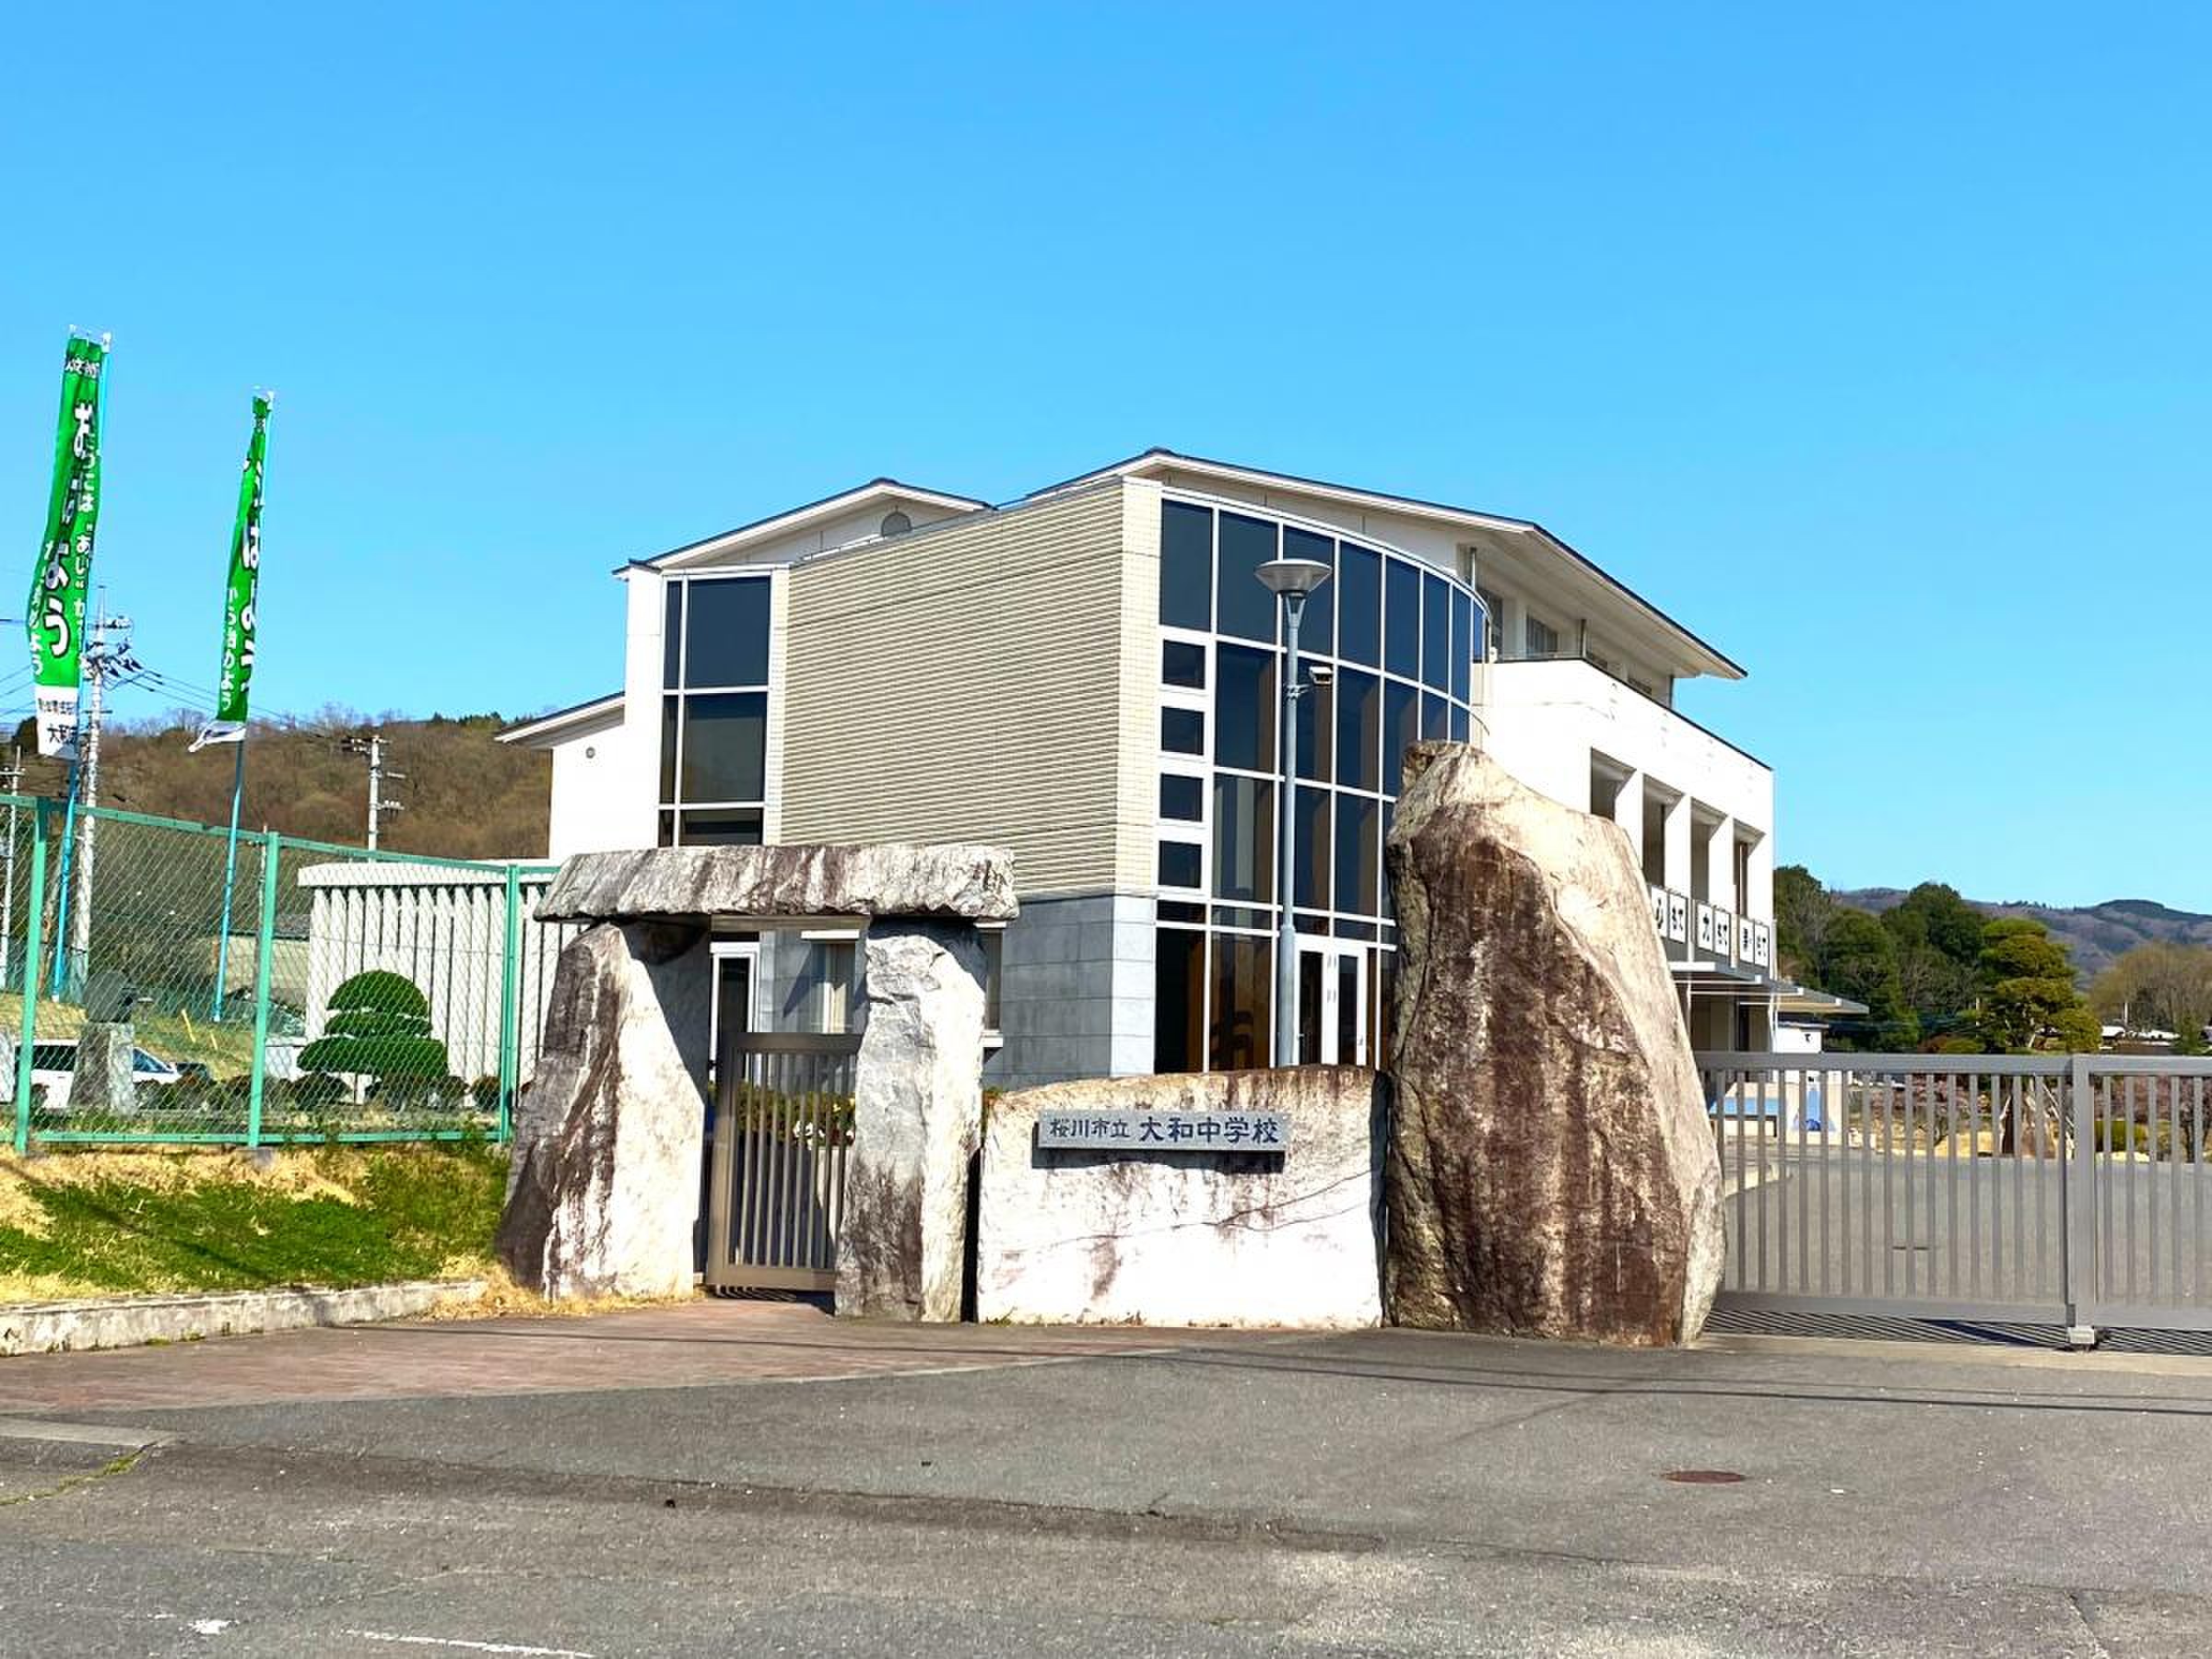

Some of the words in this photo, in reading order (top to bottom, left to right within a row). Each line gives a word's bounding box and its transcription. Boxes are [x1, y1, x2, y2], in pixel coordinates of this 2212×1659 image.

[1049, 1118, 1132, 1139] 桜川市立
[1138, 1115, 1280, 1144] 大和中学校
